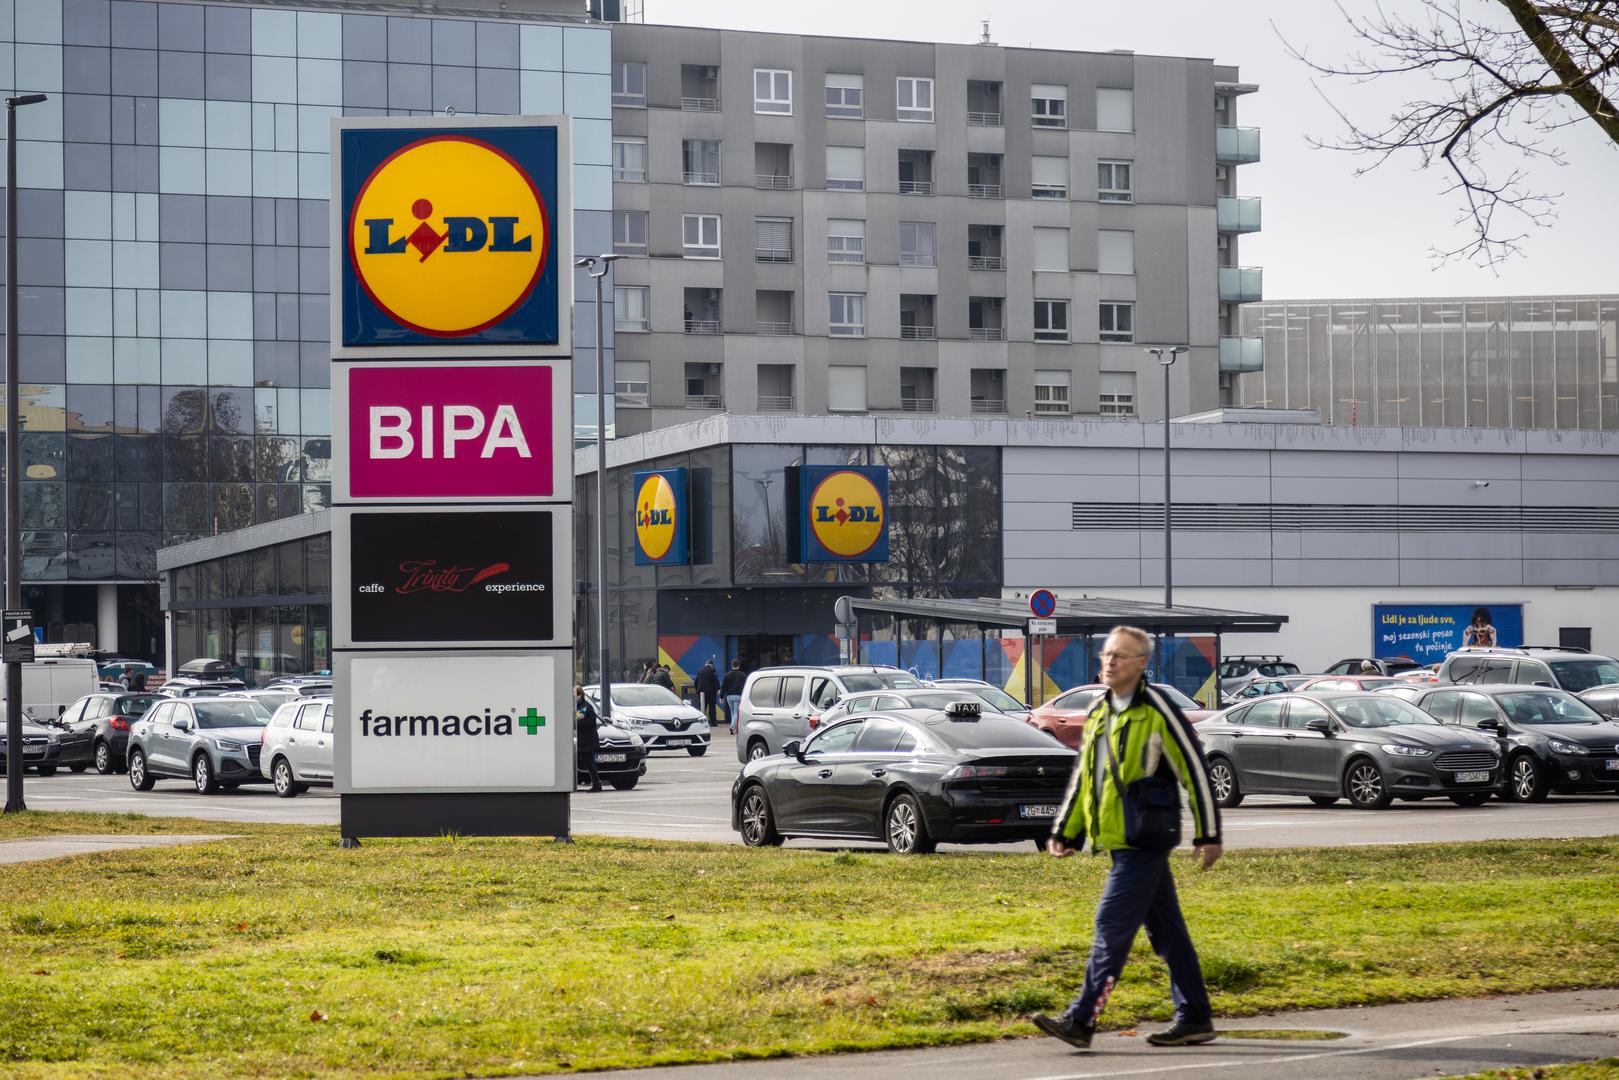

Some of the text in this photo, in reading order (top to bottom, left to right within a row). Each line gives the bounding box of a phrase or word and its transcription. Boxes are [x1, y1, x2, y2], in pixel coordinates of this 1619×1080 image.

[369, 404, 532, 460] BIPA
[359, 559, 545, 594] caffe Trinity experience
[1382, 614, 1456, 626] Lidl je za ljude sve,
[1383, 629, 1453, 644] moj sezonski posao
[1415, 642, 1424, 652] tu
[957, 704, 979, 712] TAXI
[359, 708, 513, 737] farmacia
[1026, 806, 1036, 816] ZG
